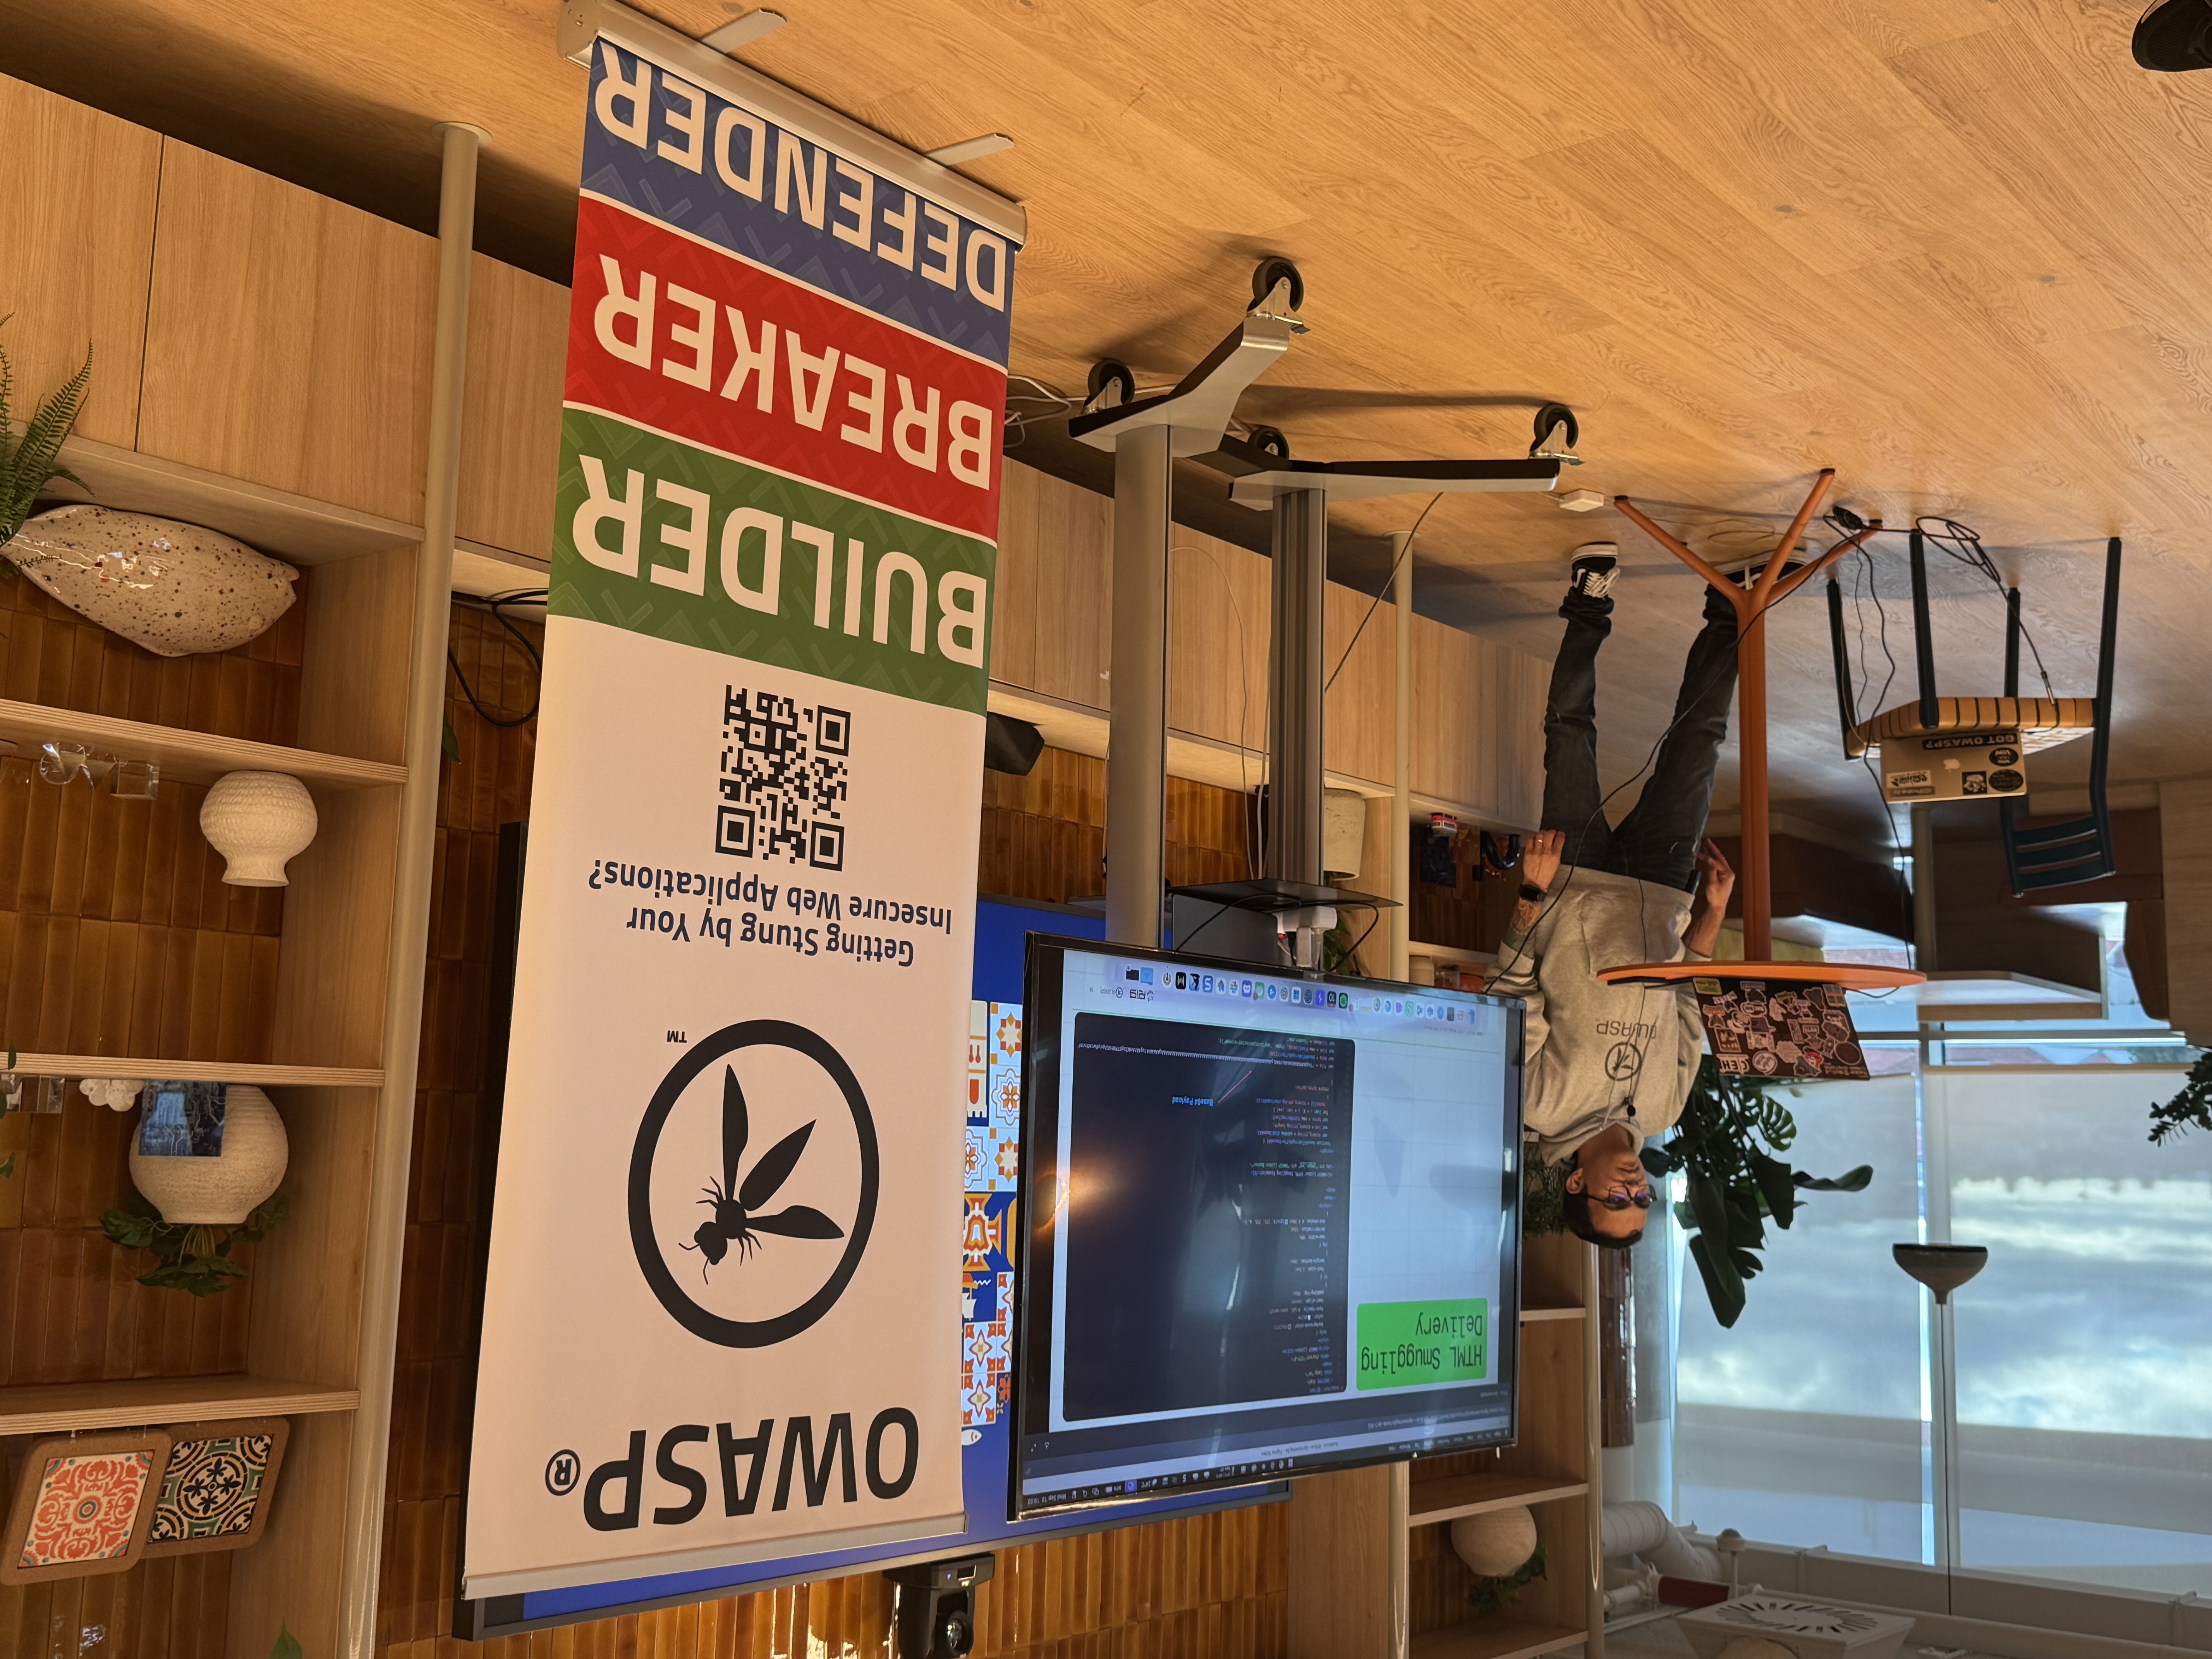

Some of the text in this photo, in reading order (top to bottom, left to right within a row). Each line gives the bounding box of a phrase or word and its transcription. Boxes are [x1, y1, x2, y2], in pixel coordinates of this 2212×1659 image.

[595, 40, 1006, 312] DEFENDER
[594, 253, 992, 491] BREAKER
[573, 454, 987, 669] BUILDER
[1925, 734, 2014, 749] GOT OWASP?
[588, 859, 951, 935] Insecure Web Applications?
[626, 907, 914, 967] Getting Stung by Your
[666, 1030, 687, 1043] TM
[1172, 1096, 1193, 1106] Payload
[1415, 1312, 1482, 1338] Delivery
[1361, 1343, 1482, 1375] HTML Smuggling
